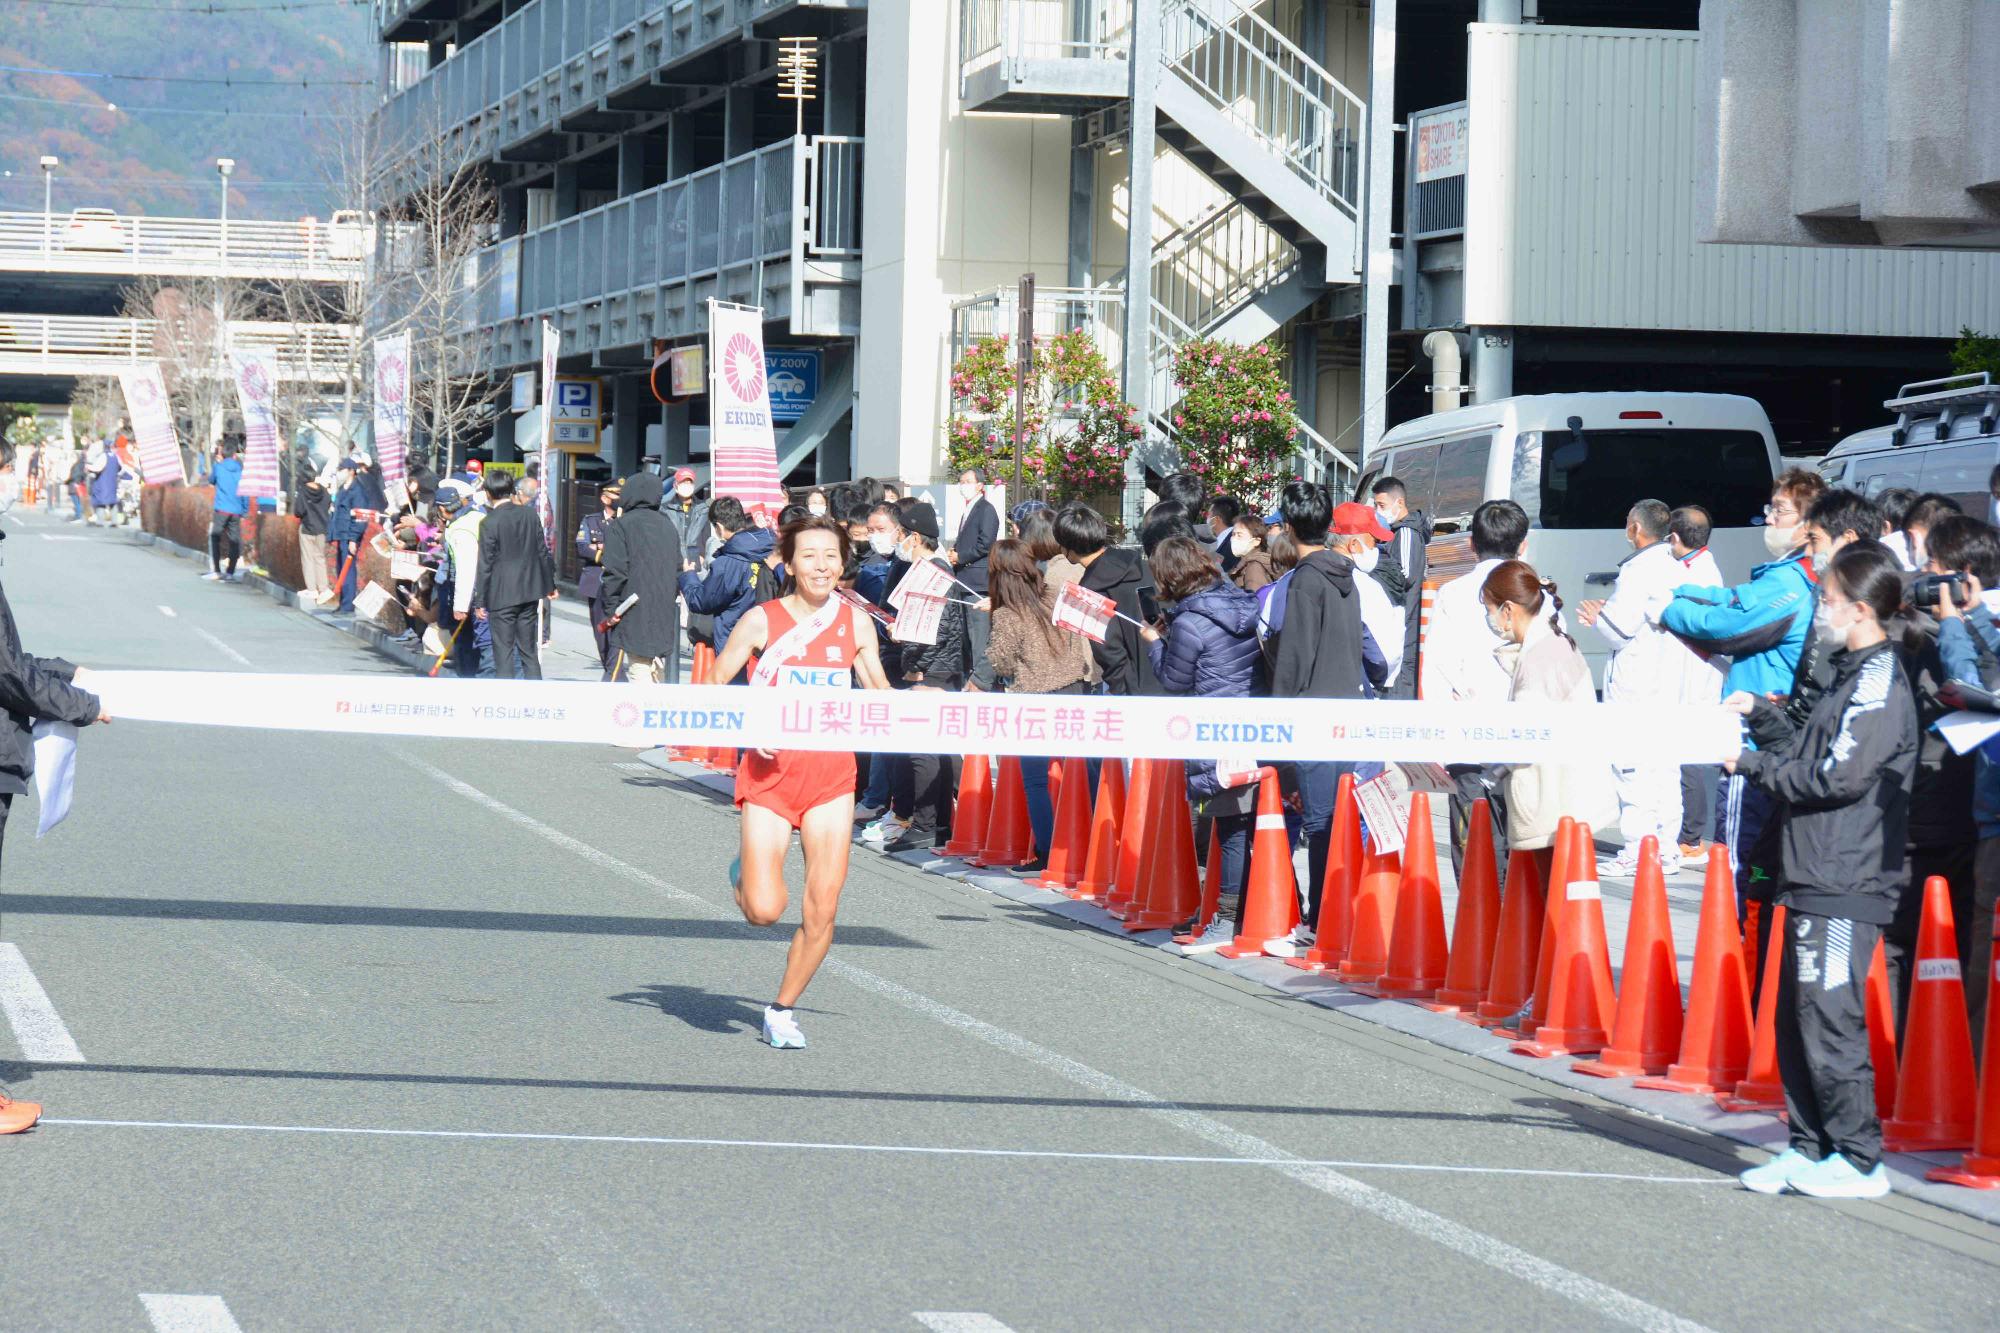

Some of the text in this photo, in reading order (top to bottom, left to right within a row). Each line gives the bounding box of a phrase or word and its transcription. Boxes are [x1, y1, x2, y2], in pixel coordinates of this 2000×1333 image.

[1430, 121, 1456, 144] TOYOTA
[1429, 146, 1452, 170] SHARE
[780, 358, 809, 369] 200V
[563, 384, 587, 405] P
[559, 407, 591, 417] 入口
[724, 410, 767, 427] EKIDEN
[789, 670, 844, 687] NEC
[354, 703, 567, 720] 山梨日日新聞社 YBS山梨放送
[643, 710, 744, 730] EKIDEN
[781, 699, 1125, 742] 山梨県一周駅伝競走
[1196, 723, 1293, 743] EKIDEN
